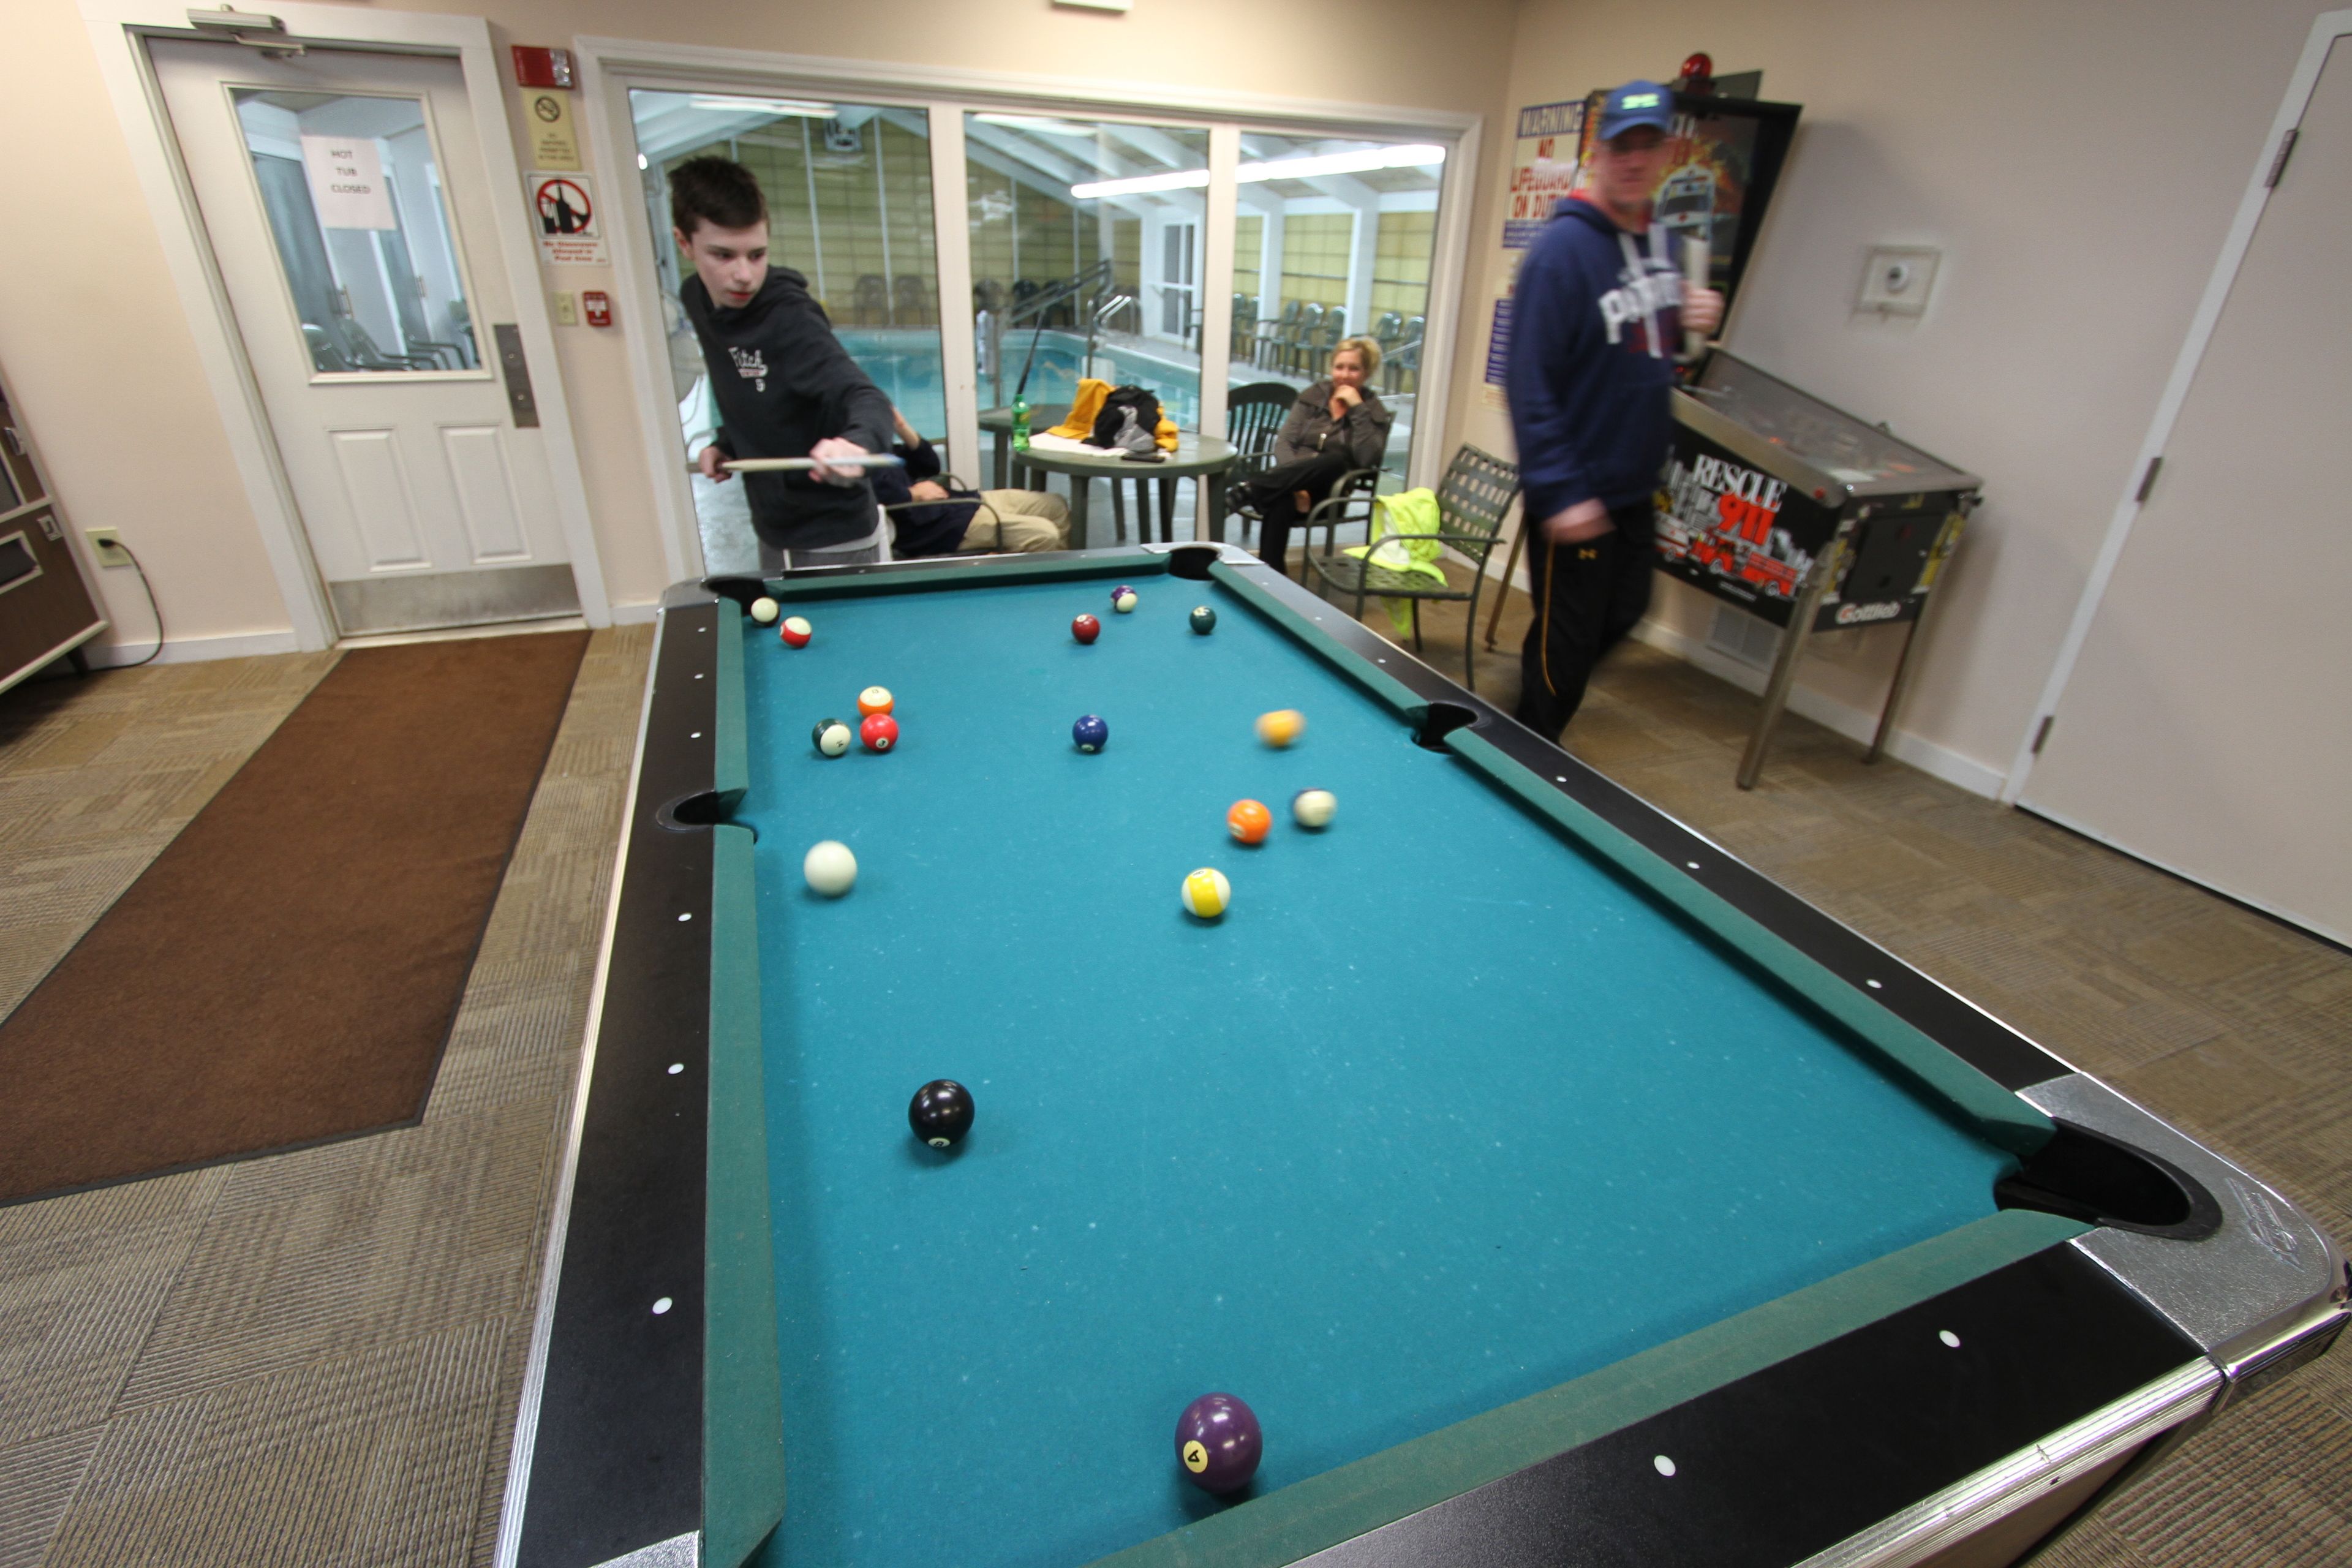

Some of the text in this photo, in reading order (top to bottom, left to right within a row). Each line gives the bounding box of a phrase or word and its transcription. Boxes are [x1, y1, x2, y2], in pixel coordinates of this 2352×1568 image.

[1521, 103, 1583, 136] WARNING
[330, 149, 353, 159] HOT
[1538, 138, 1555, 158] NO
[336, 167, 358, 176] TUB
[331, 184, 371, 194] CLOSED
[1513, 195, 1528, 218] ON
[1693, 454, 1788, 513] RESCUE
[1717, 493, 1777, 546] 911
[1188, 1449, 1200, 1462] 4
